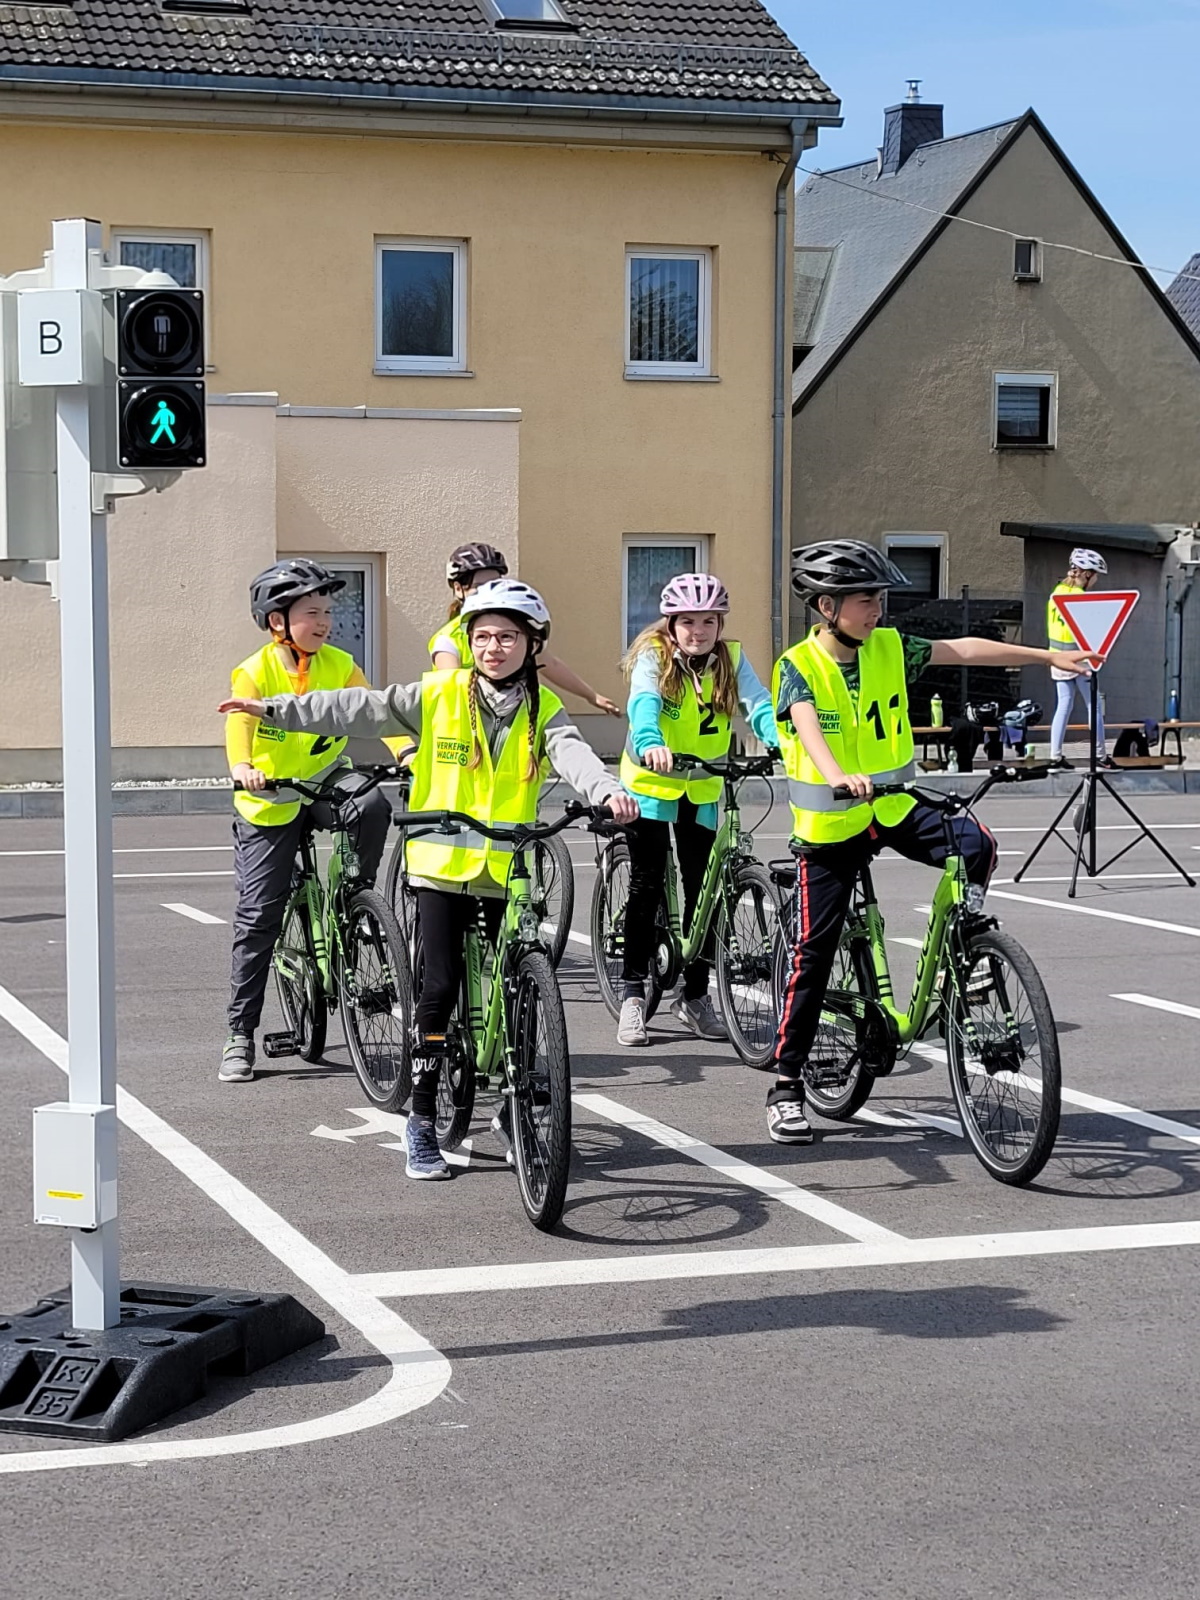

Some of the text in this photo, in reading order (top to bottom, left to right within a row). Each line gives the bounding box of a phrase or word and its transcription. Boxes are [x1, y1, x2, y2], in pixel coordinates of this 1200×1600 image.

[39, 321, 63, 355] B
[436, 741, 470, 753] VERKEHRS
[436, 750, 459, 760] WACHT
[54, 1364, 94, 1384] K1
